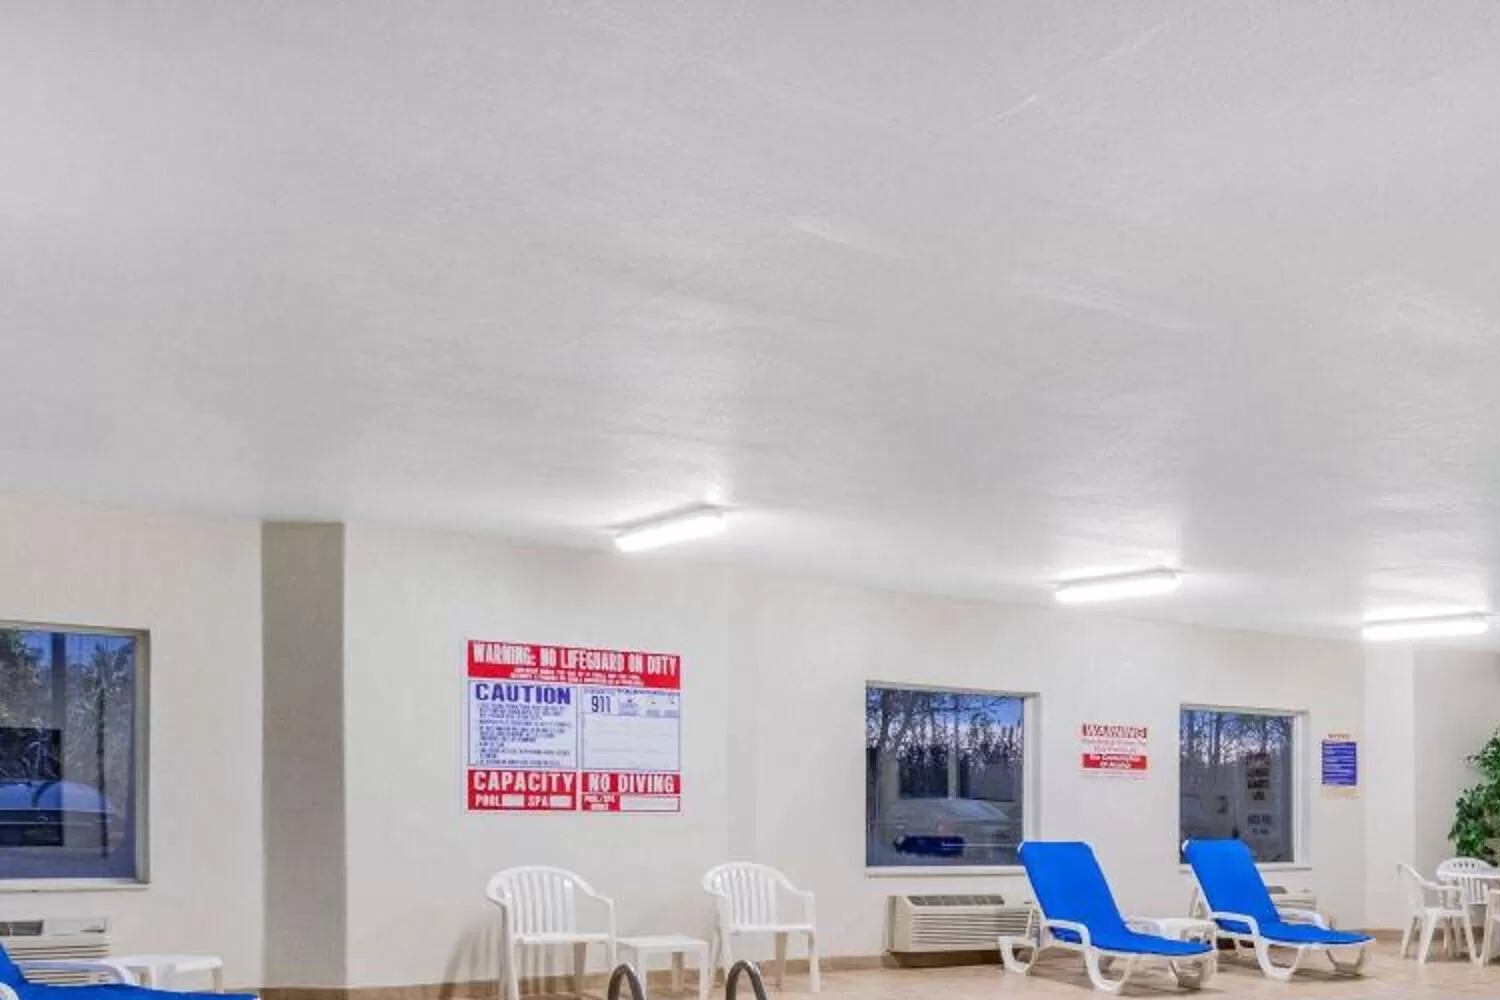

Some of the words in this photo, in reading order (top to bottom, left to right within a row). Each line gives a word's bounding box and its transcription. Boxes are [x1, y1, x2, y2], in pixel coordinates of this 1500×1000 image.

[539, 647, 557, 667] NO
[560, 648, 625, 672] LIFEGUARD
[628, 653, 644, 673] ON
[647, 655, 677, 677] DUTY
[475, 683, 571, 705] CAUTION
[591, 695, 612, 713] 911
[473, 771, 574, 792] CAPACITY
[589, 773, 610, 792] NO
[618, 774, 675, 793] DIVING
[475, 794, 502, 807] POOL
[527, 795, 549, 807] SPA
